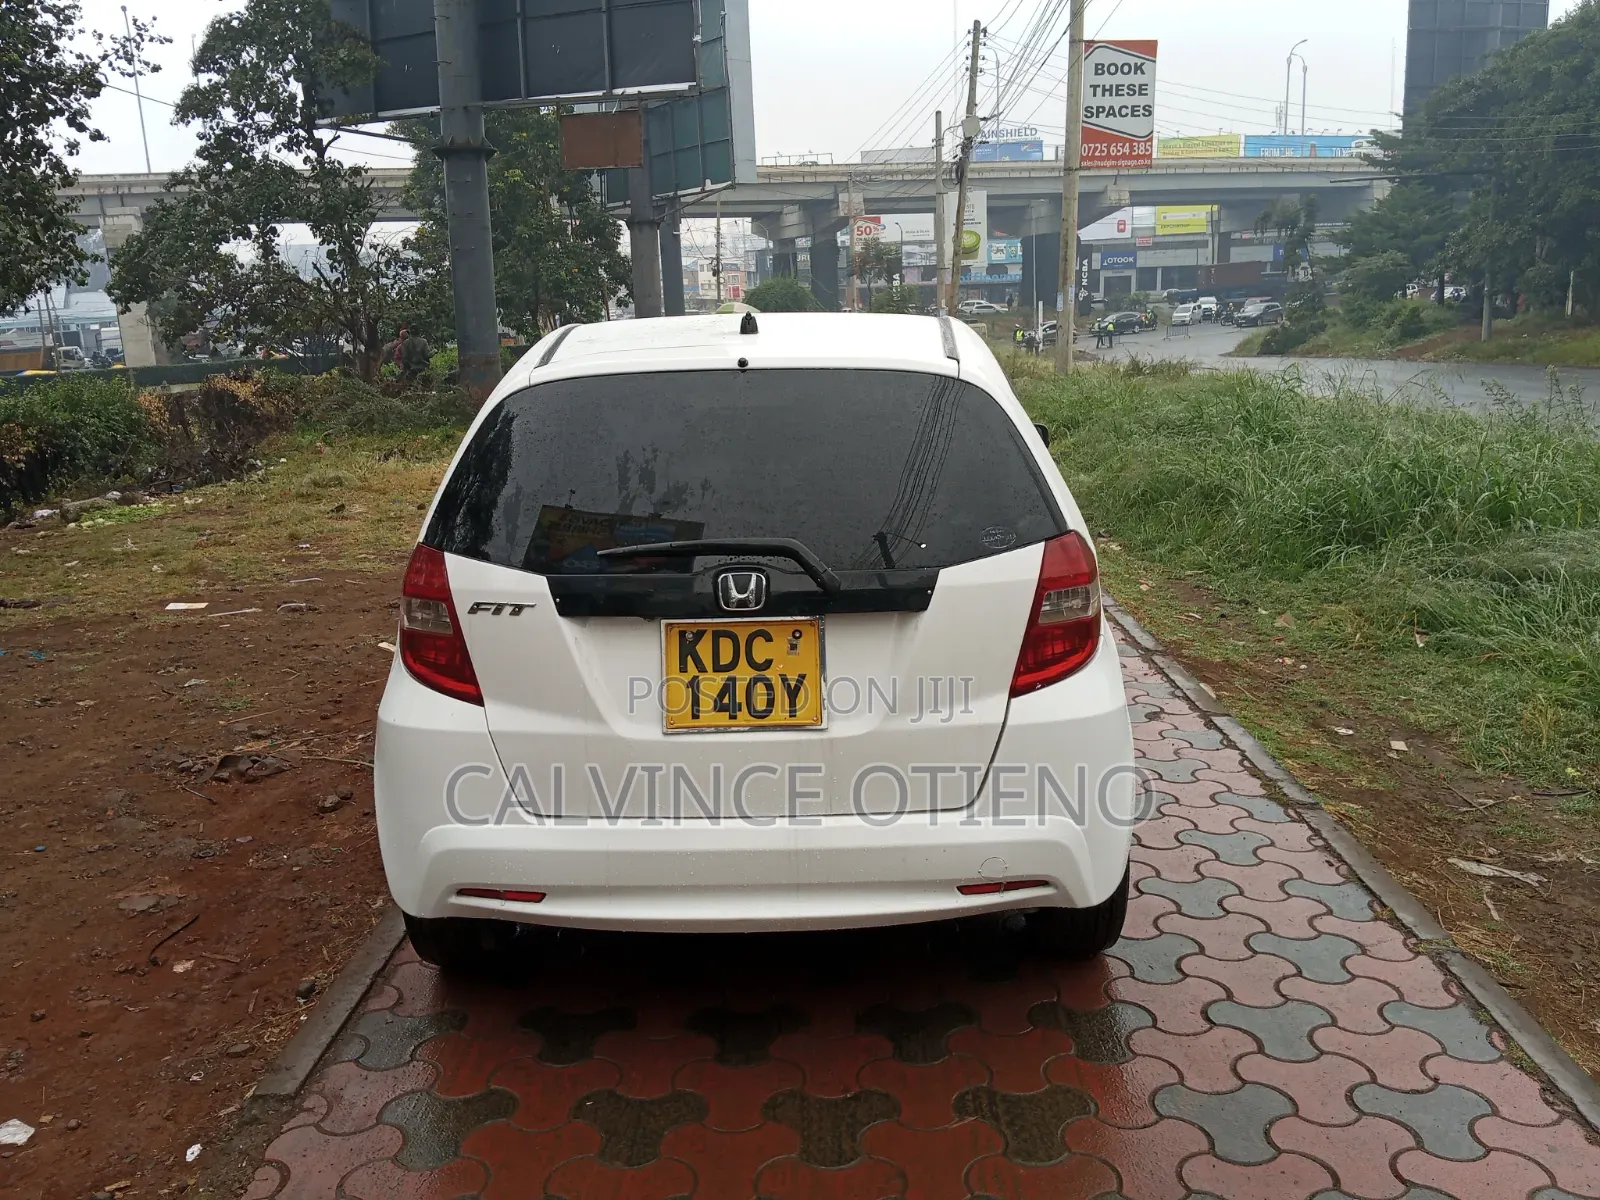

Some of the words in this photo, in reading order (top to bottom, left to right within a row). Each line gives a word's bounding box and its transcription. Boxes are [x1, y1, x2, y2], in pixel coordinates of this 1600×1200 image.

[1094, 62, 1146, 76] BOOK
[1089, 83, 1149, 97] THESE
[1083, 104, 1153, 118] SPACES
[974, 126, 1038, 140] AINSHIELD
[1081, 143, 1108, 157] 0725
[1109, 143, 1130, 156] 654
[1131, 142, 1152, 155] 385
[1081, 259, 1089, 286] NCBA
[467, 601, 537, 617] FIT
[677, 628, 774, 674] KDC
[686, 673, 807, 721] 140Y
